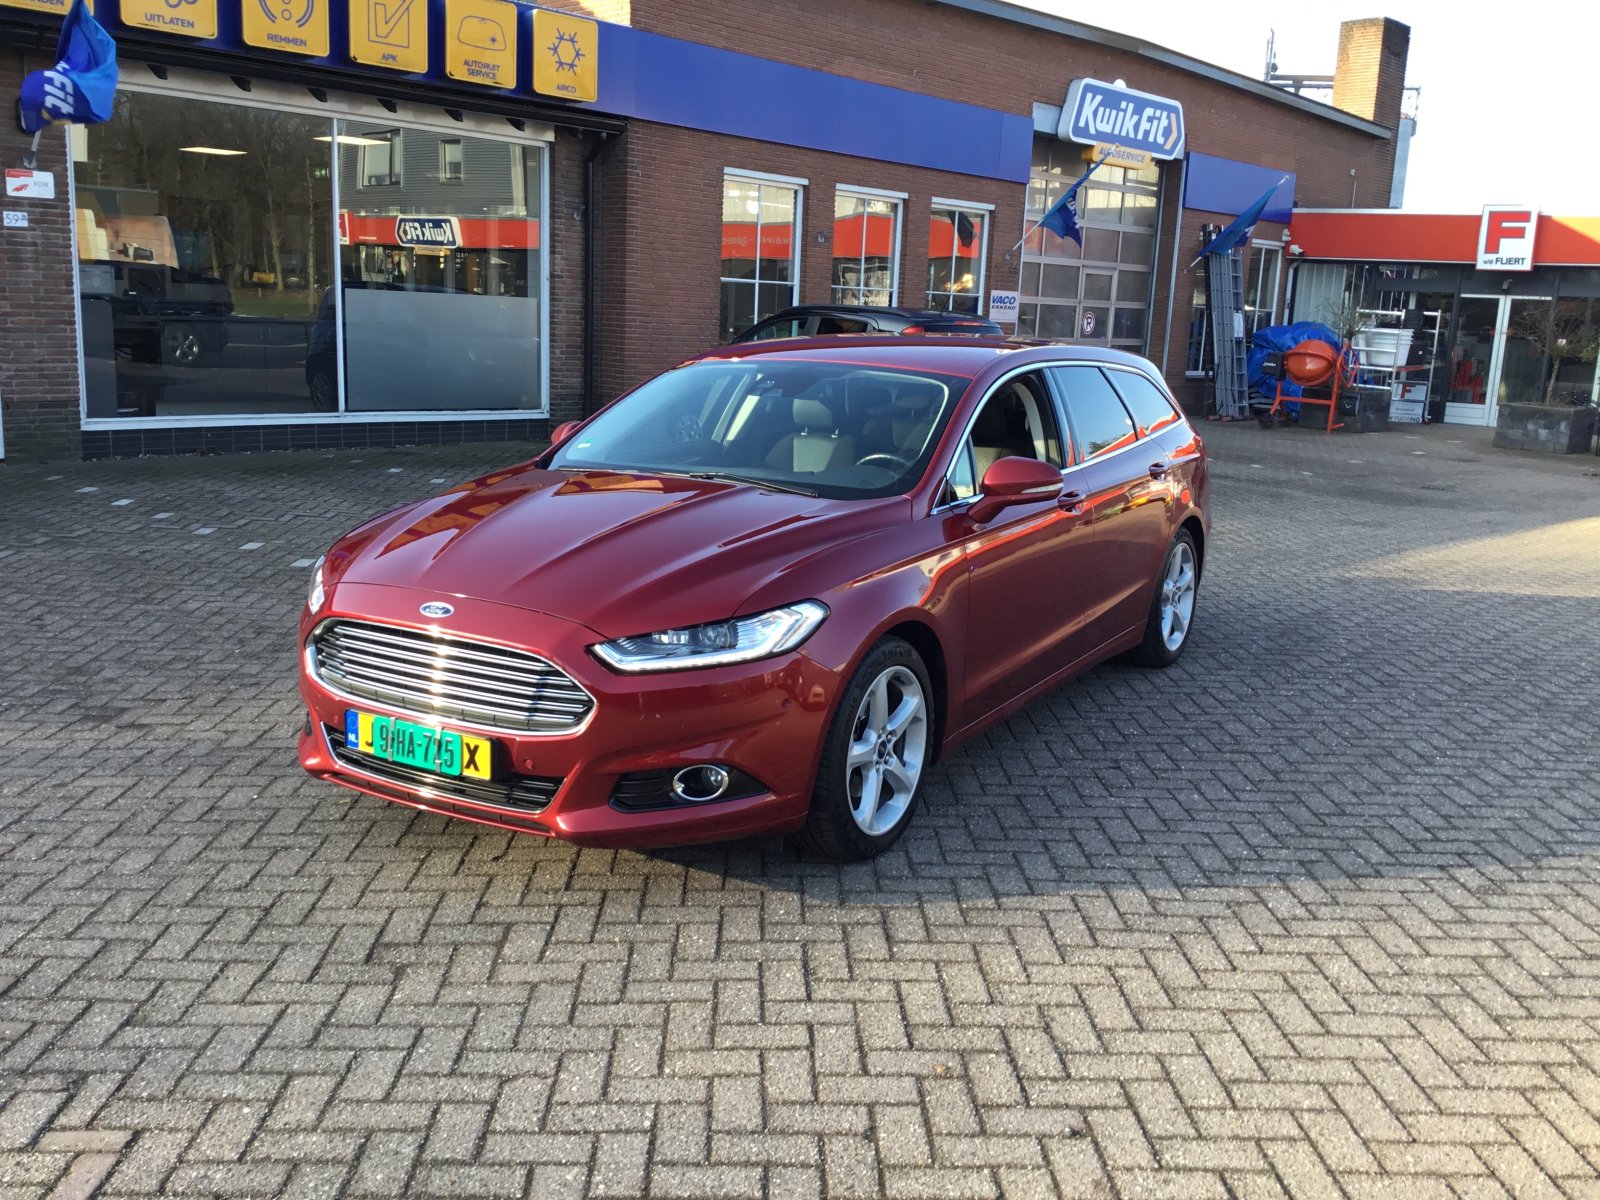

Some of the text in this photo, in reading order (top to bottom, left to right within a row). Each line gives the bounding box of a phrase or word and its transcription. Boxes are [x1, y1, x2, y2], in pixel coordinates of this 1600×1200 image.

[144, 12, 195, 29] UITLATEN
[267, 33, 307, 47] REMMEN
[381, 53, 398, 62] APK
[463, 59, 500, 72] AUTORUIT
[467, 68, 497, 80] SERVICE
[556, 83, 577, 94] AIRCO
[1484, 210, 1532, 254] F
[1494, 257, 1526, 266] FLIERT
[991, 295, 1017, 305] VACO
[1400, 383, 1417, 400] F
[348, 733, 358, 743] NL
